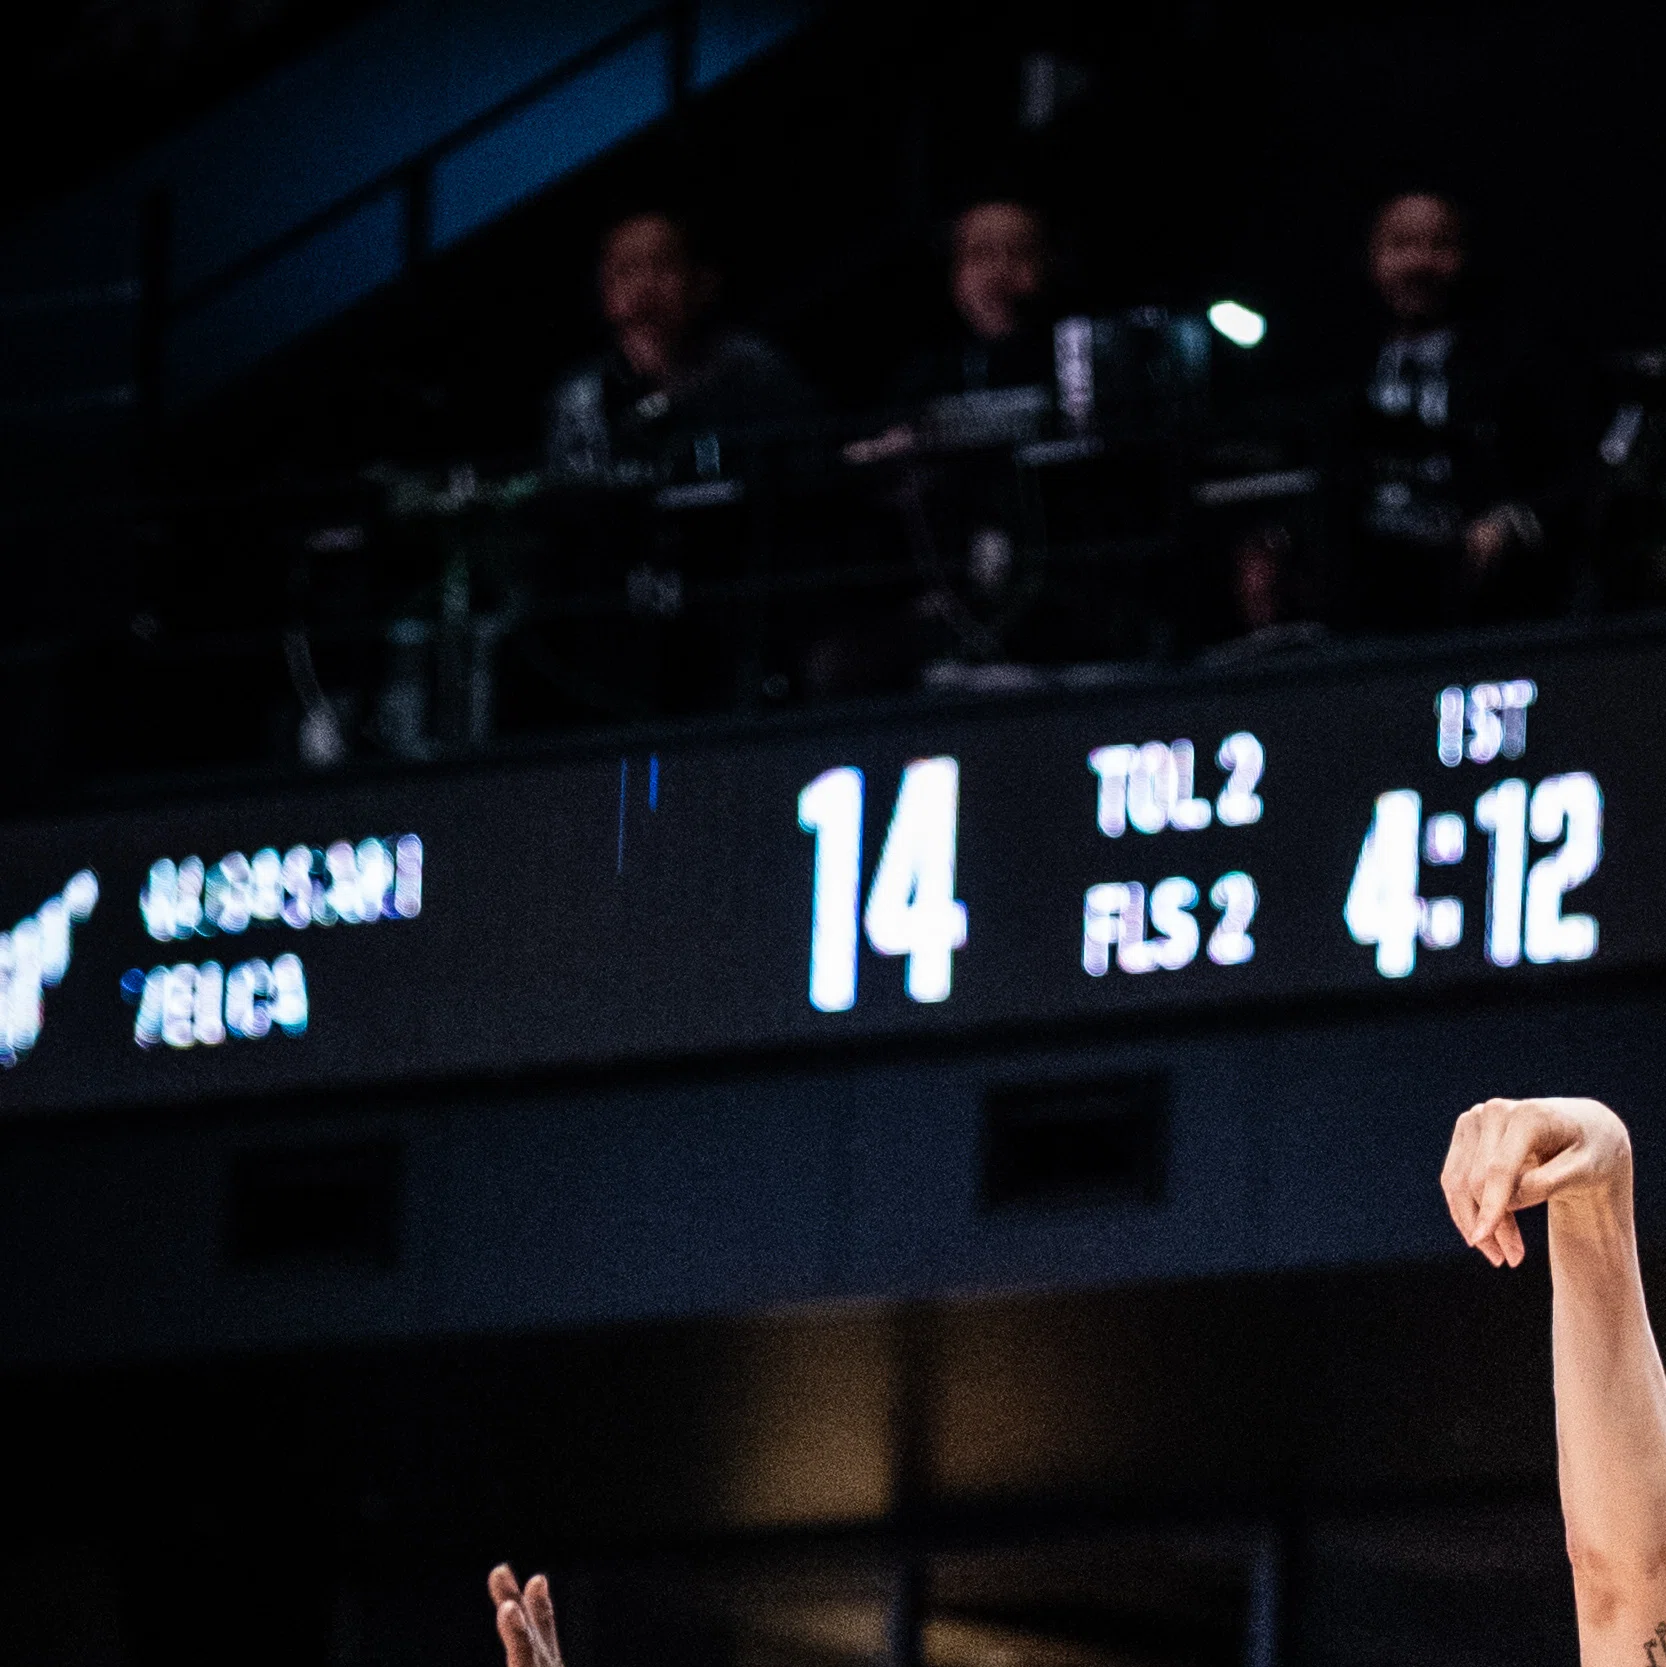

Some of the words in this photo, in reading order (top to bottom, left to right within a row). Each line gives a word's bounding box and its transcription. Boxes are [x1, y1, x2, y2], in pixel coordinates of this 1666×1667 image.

[1216, 731, 1266, 827] 2
[798, 756, 967, 1012] 14
[1083, 876, 1199, 976] FLS
[1208, 871, 1258, 965] 2
[1344, 771, 1602, 979] 4:12
